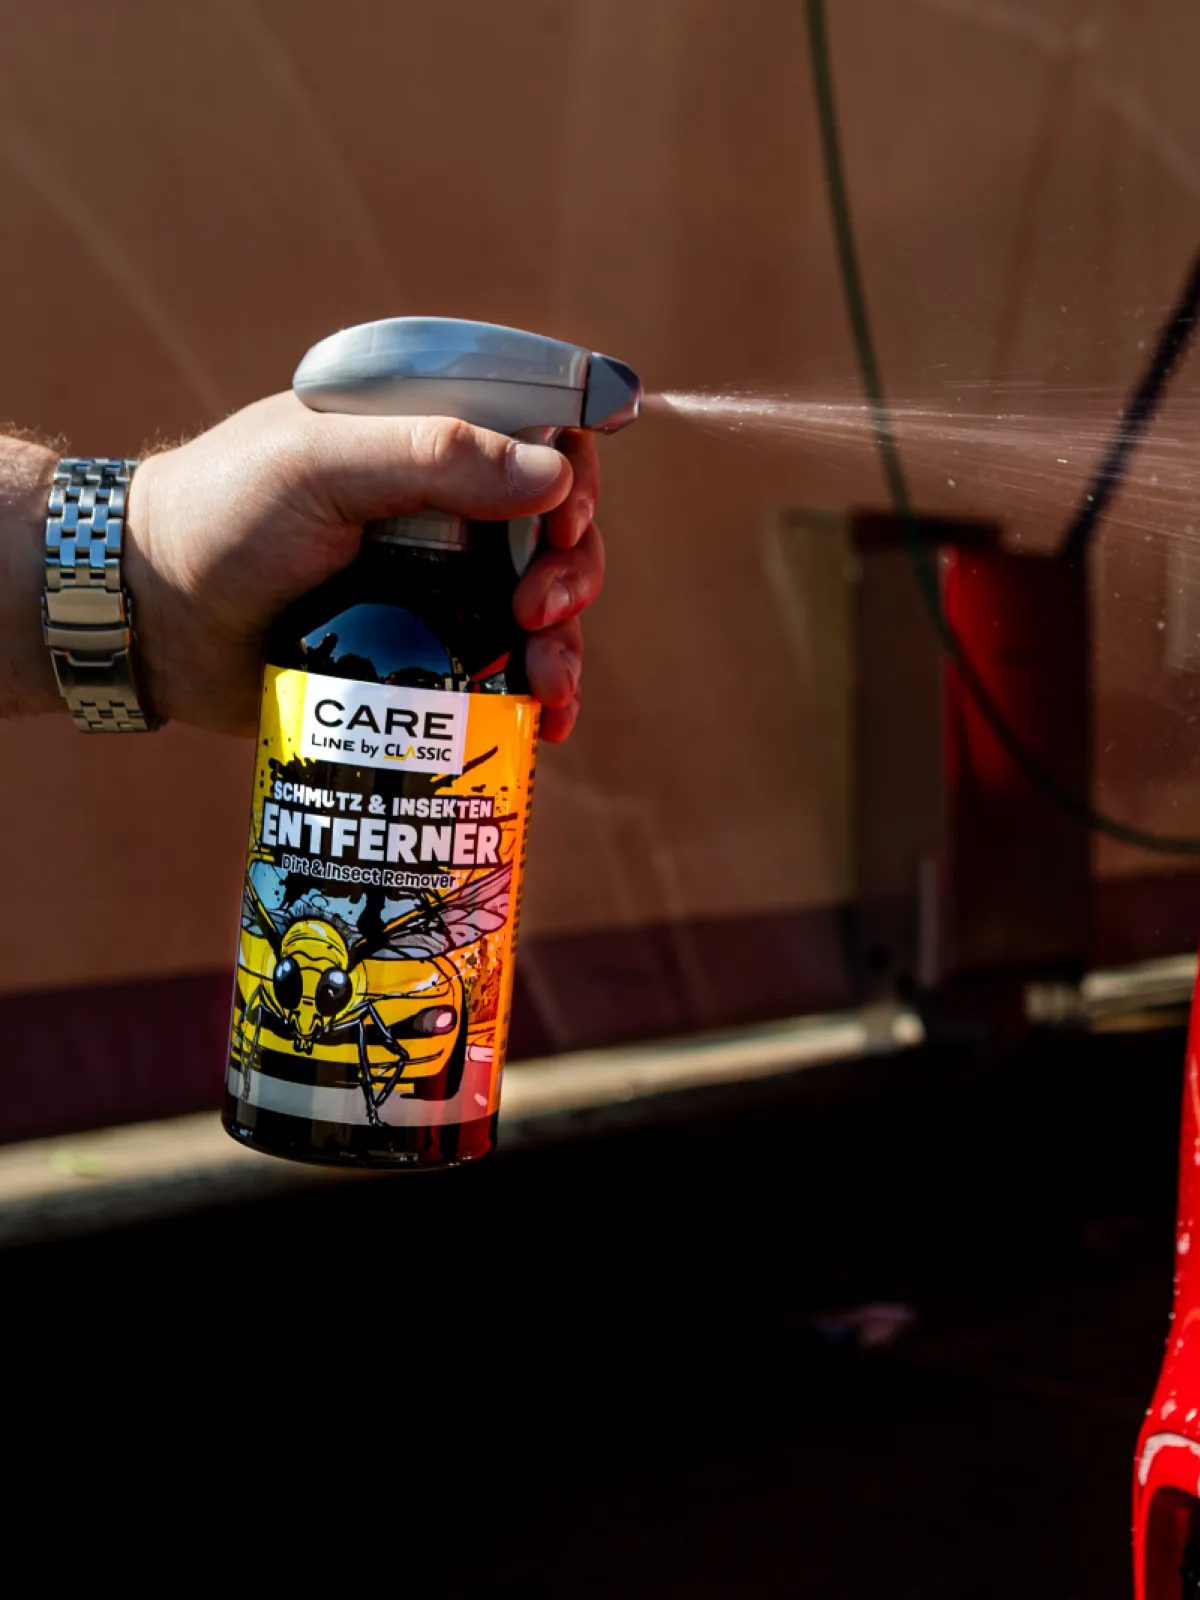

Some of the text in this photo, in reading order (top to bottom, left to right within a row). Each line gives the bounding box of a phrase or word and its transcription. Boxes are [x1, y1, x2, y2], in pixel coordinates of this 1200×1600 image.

[314, 699, 454, 741] CARE
[361, 739, 379, 758] by
[384, 744, 452, 762] CLASSIC
[273, 780, 492, 819] SCHMUTZ & INSEKTEN
[261, 802, 500, 866] ENTFERNER
[281, 853, 457, 889] Dirt & Insect Remover
